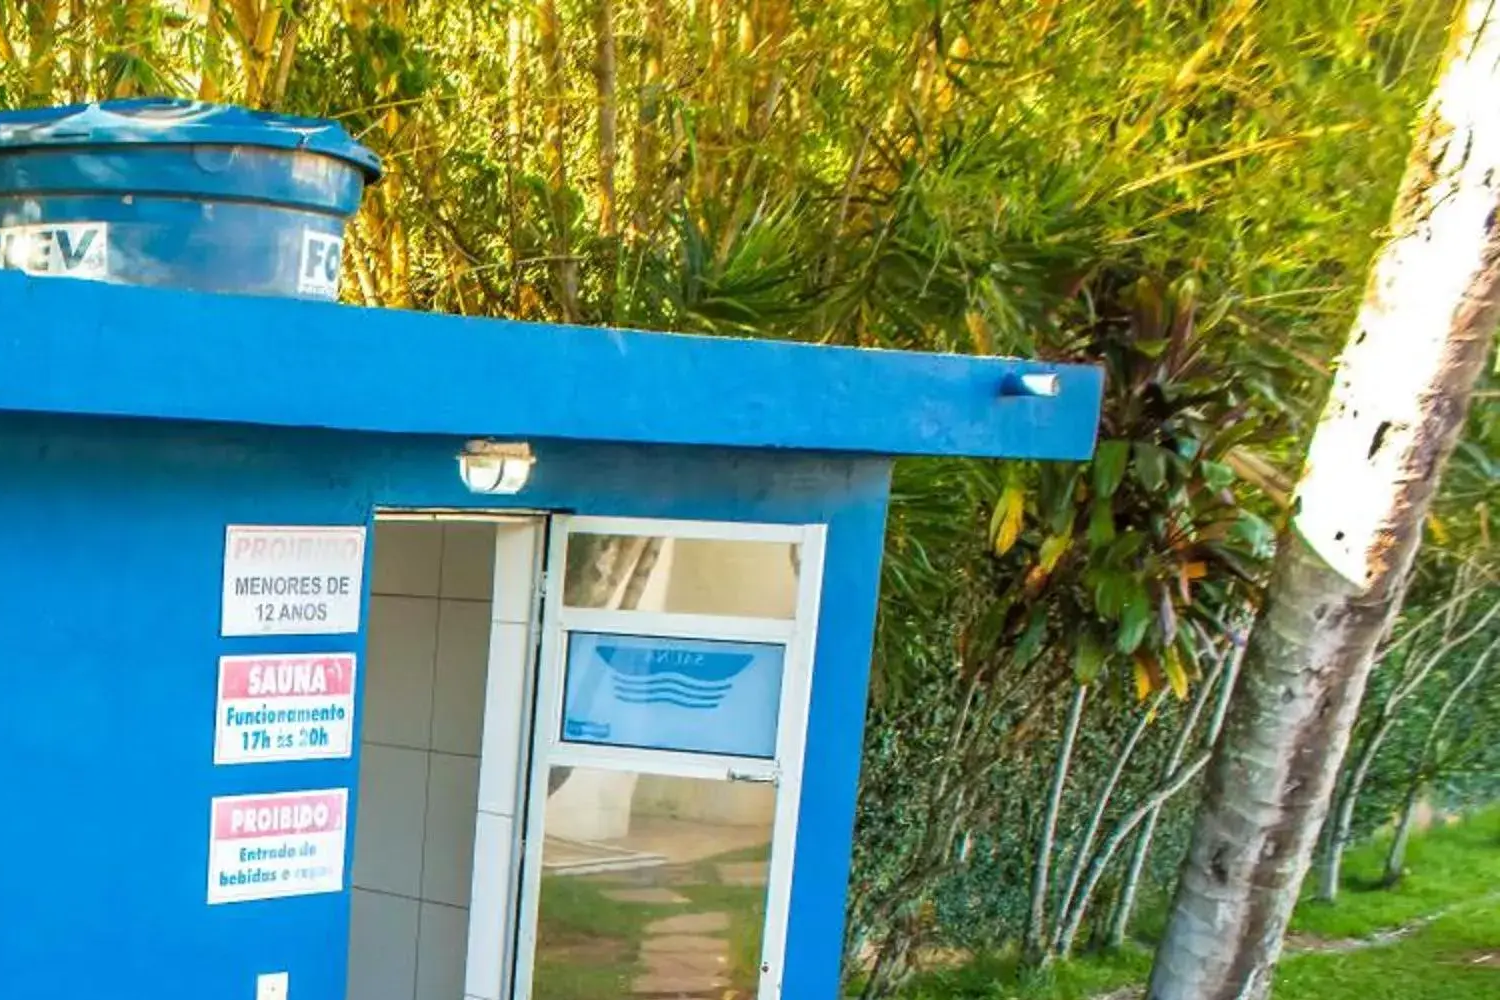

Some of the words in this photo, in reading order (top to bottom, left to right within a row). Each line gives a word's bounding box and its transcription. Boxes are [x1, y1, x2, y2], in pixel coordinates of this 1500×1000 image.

[235, 576, 321, 596] MENORES
[327, 577, 349, 595] DE
[256, 603, 274, 621] 12
[278, 603, 327, 621] ANOS
[248, 664, 327, 695] SAUNA
[226, 704, 345, 726] Funcionamento
[242, 731, 270, 750] 17h
[299, 727, 328, 748] 20h
[231, 803, 329, 833] PROIBIDO
[239, 841, 296, 862] Entrada
[219, 868, 277, 887] bebidas
[281, 869, 291, 880] e
